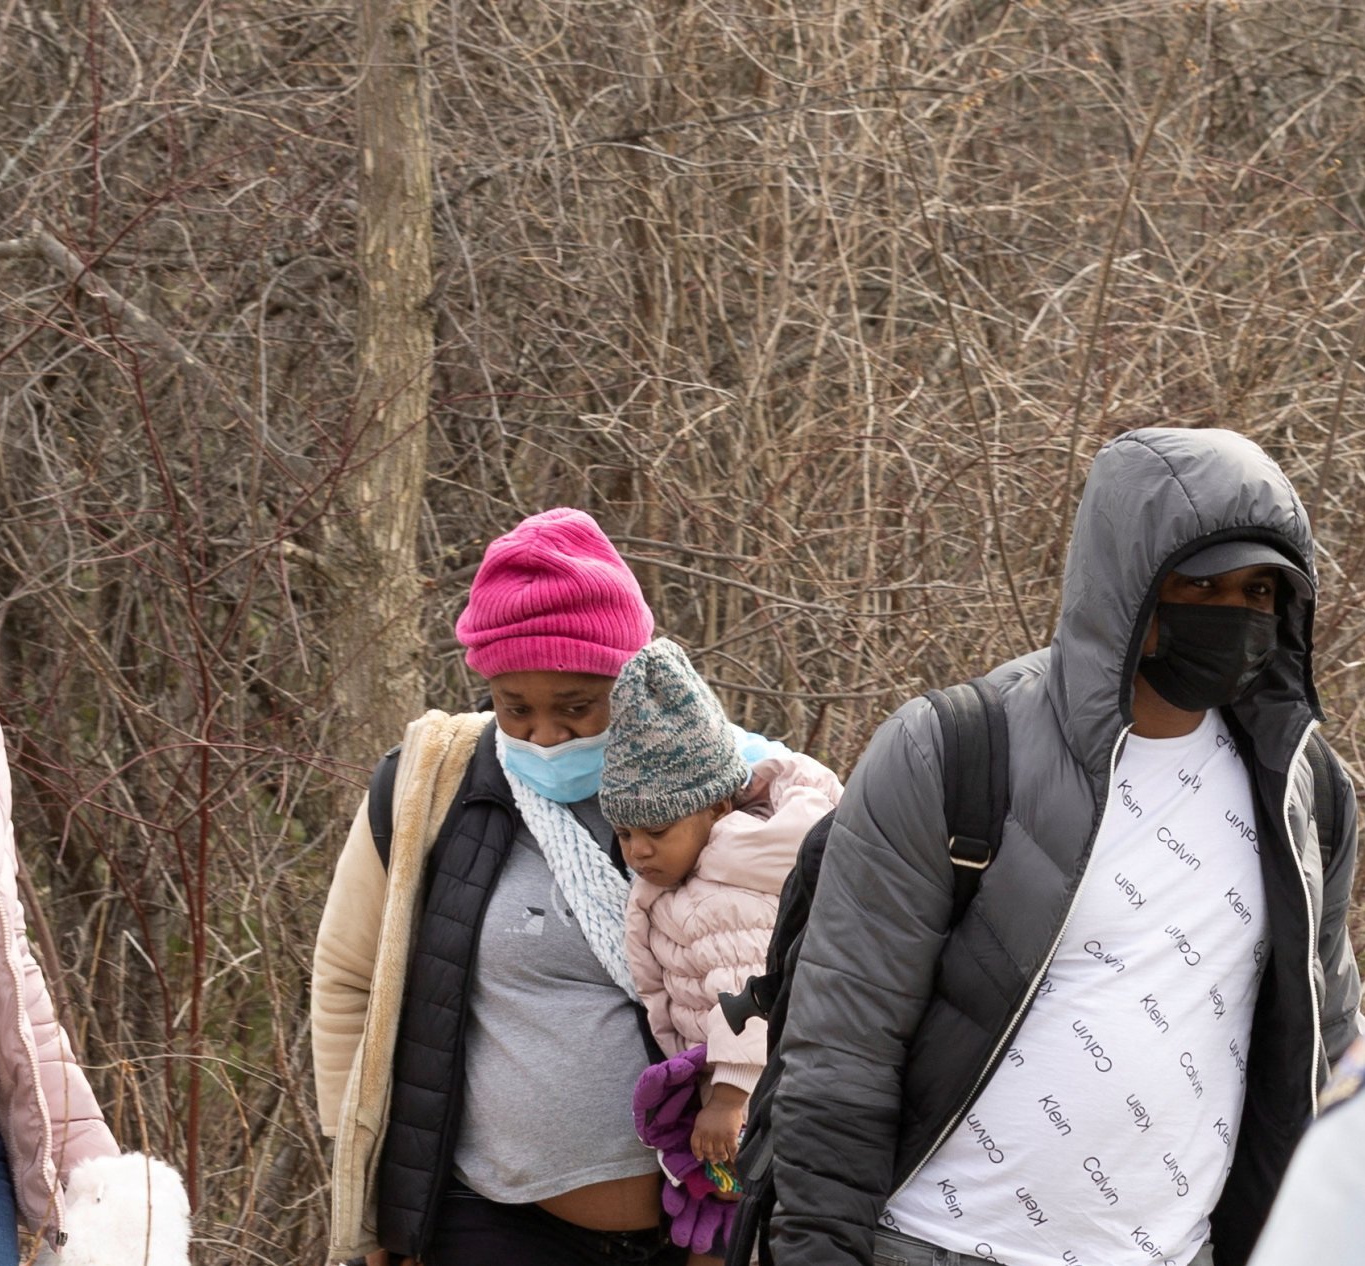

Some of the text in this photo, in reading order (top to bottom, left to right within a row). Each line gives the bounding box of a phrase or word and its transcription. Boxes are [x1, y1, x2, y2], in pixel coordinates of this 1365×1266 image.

[1117, 779, 1201, 871] Klein Calvin
[1114, 873, 1201, 966] Calvin Klein
[1224, 887, 1252, 925] Klein
[1084, 940, 1170, 1033] Calvin Klein
[966, 1113, 1005, 1164] Calvin
[1072, 1019, 1189, 1197] Calvin Klein Calvin
[1179, 1051, 1231, 1147] Calvin Kle
[1038, 1094, 1072, 1137] Klein
[1083, 1156, 1119, 1206] Calvin
[937, 1178, 964, 1219] Klein
[1015, 1186, 1048, 1227] Klein
